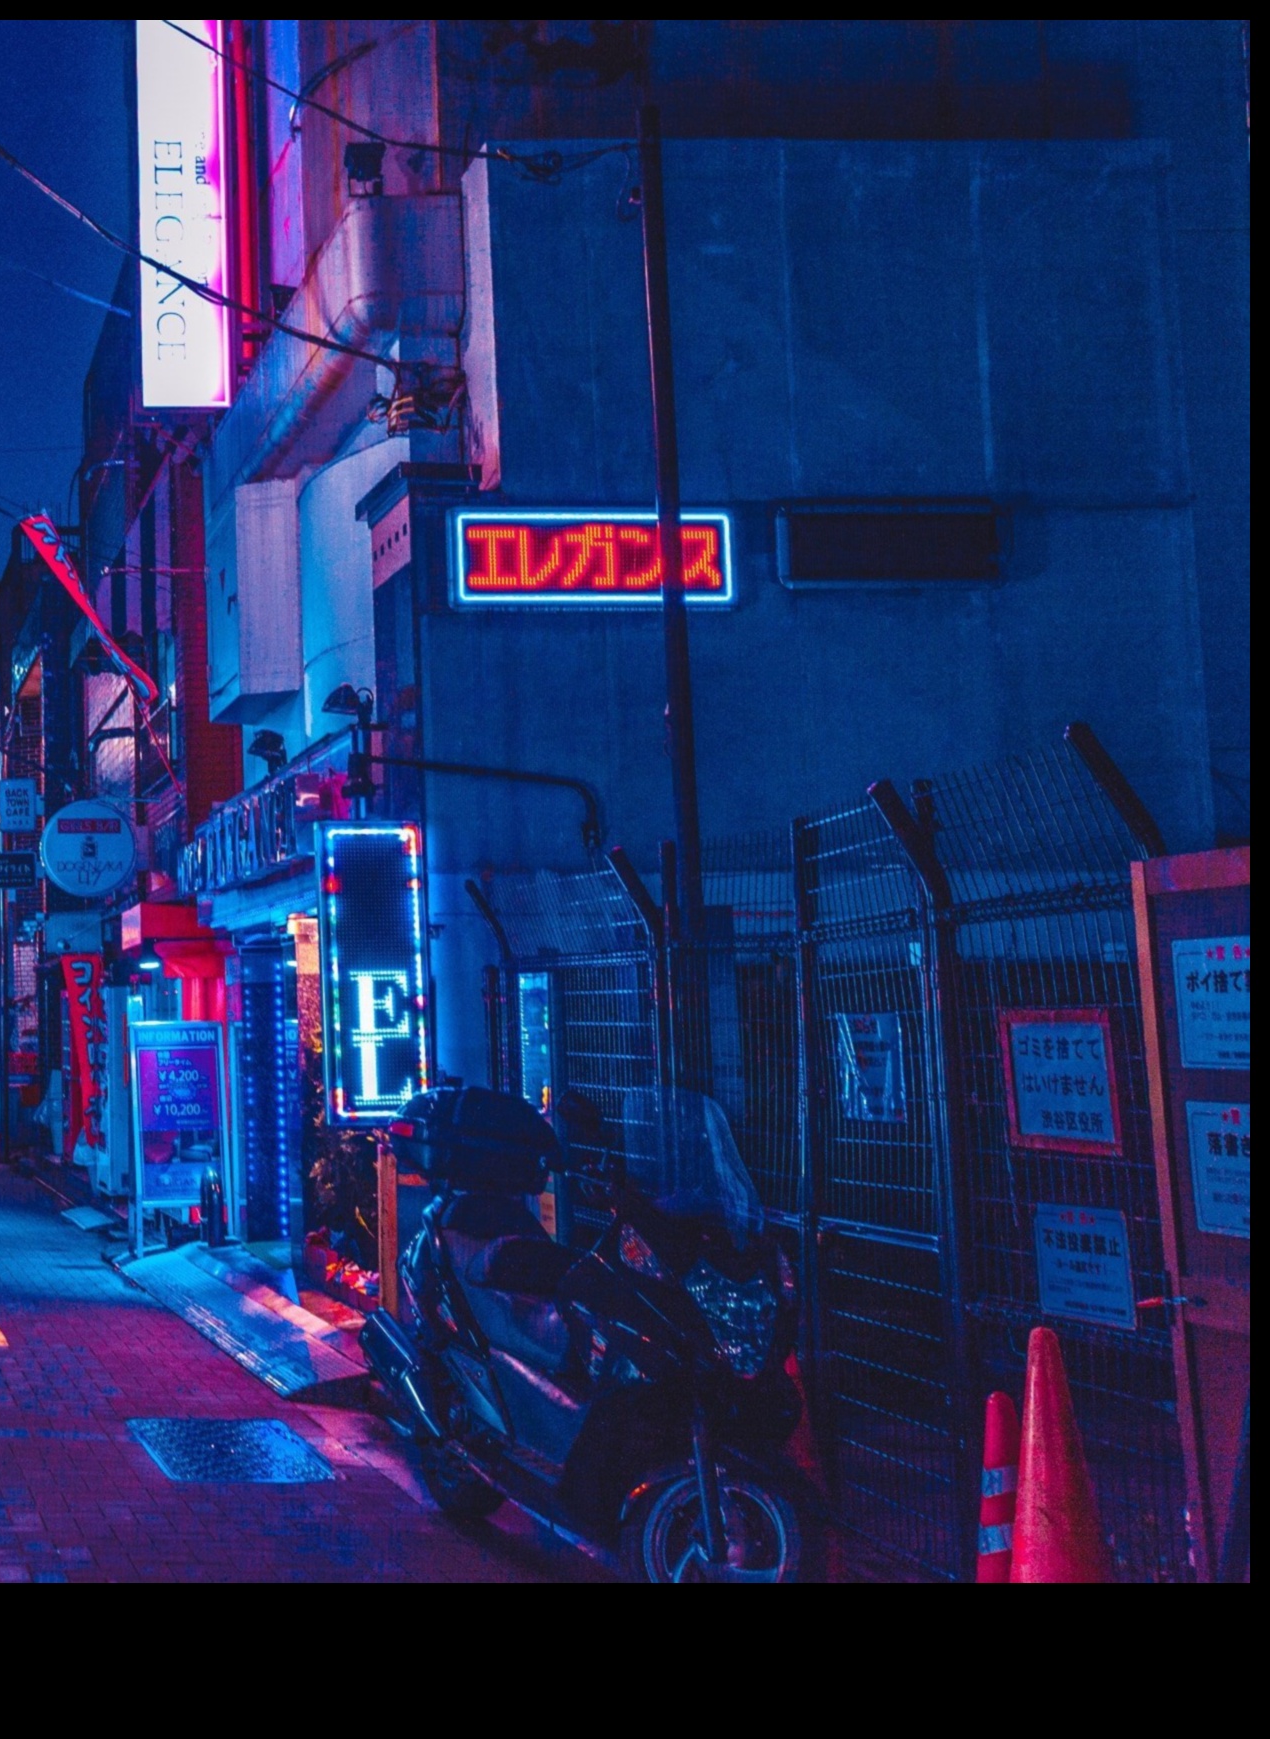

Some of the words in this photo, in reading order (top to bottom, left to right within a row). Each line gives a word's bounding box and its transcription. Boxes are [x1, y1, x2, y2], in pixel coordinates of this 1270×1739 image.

[466, 524, 722, 588] エレガンス
[5, 788, 29, 798] BACK
[5, 798, 30, 807] TOWN
[138, 1029, 215, 1043] INFORMATION
[1018, 1034, 1100, 1060] ゴミを捨てて
[1022, 1072, 1105, 1097] はいけません
